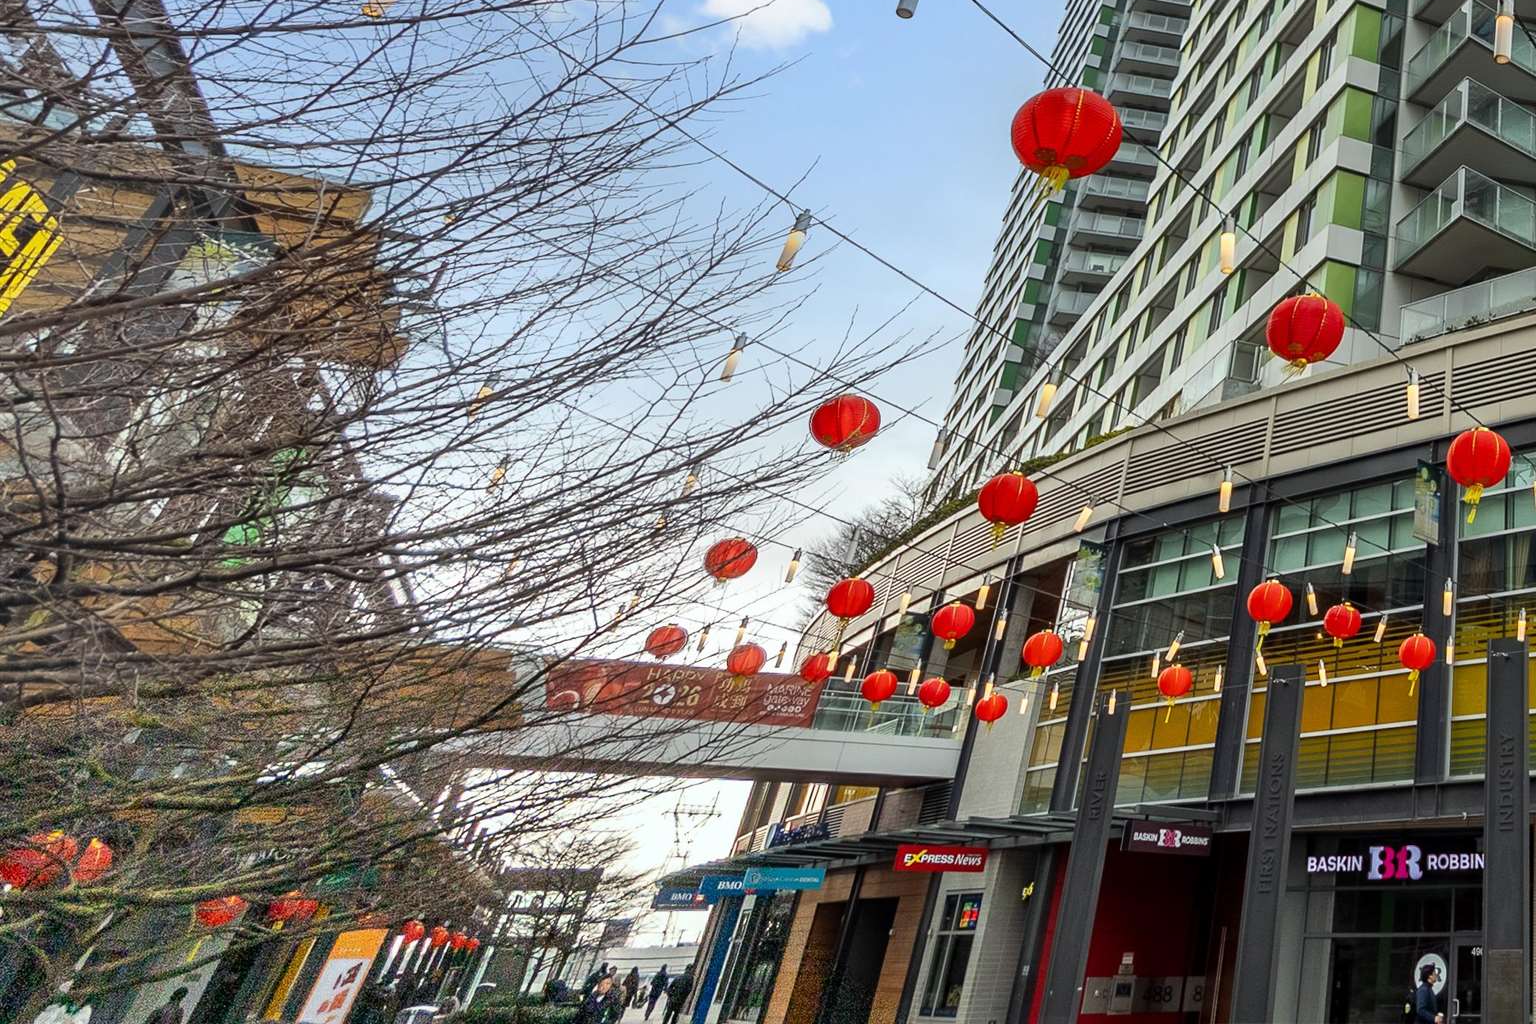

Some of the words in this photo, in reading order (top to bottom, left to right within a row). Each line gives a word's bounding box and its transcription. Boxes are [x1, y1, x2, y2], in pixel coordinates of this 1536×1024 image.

[1498, 733, 1516, 833] INDUSTRY
[1088, 772, 1107, 821] RIVER
[1264, 752, 1285, 839] NATIONS
[1133, 831, 1158, 842] BASKIN
[1181, 834, 1210, 846] ROBBINS
[903, 849, 955, 867] EXPRESS
[954, 853, 983, 866] News
[1306, 854, 1362, 873] BASKIN
[1426, 852, 1486, 871] ROBBIN
[1257, 846, 1276, 894] FIRST
[717, 880, 743, 891] BMO
[670, 892, 693, 901] BMO
